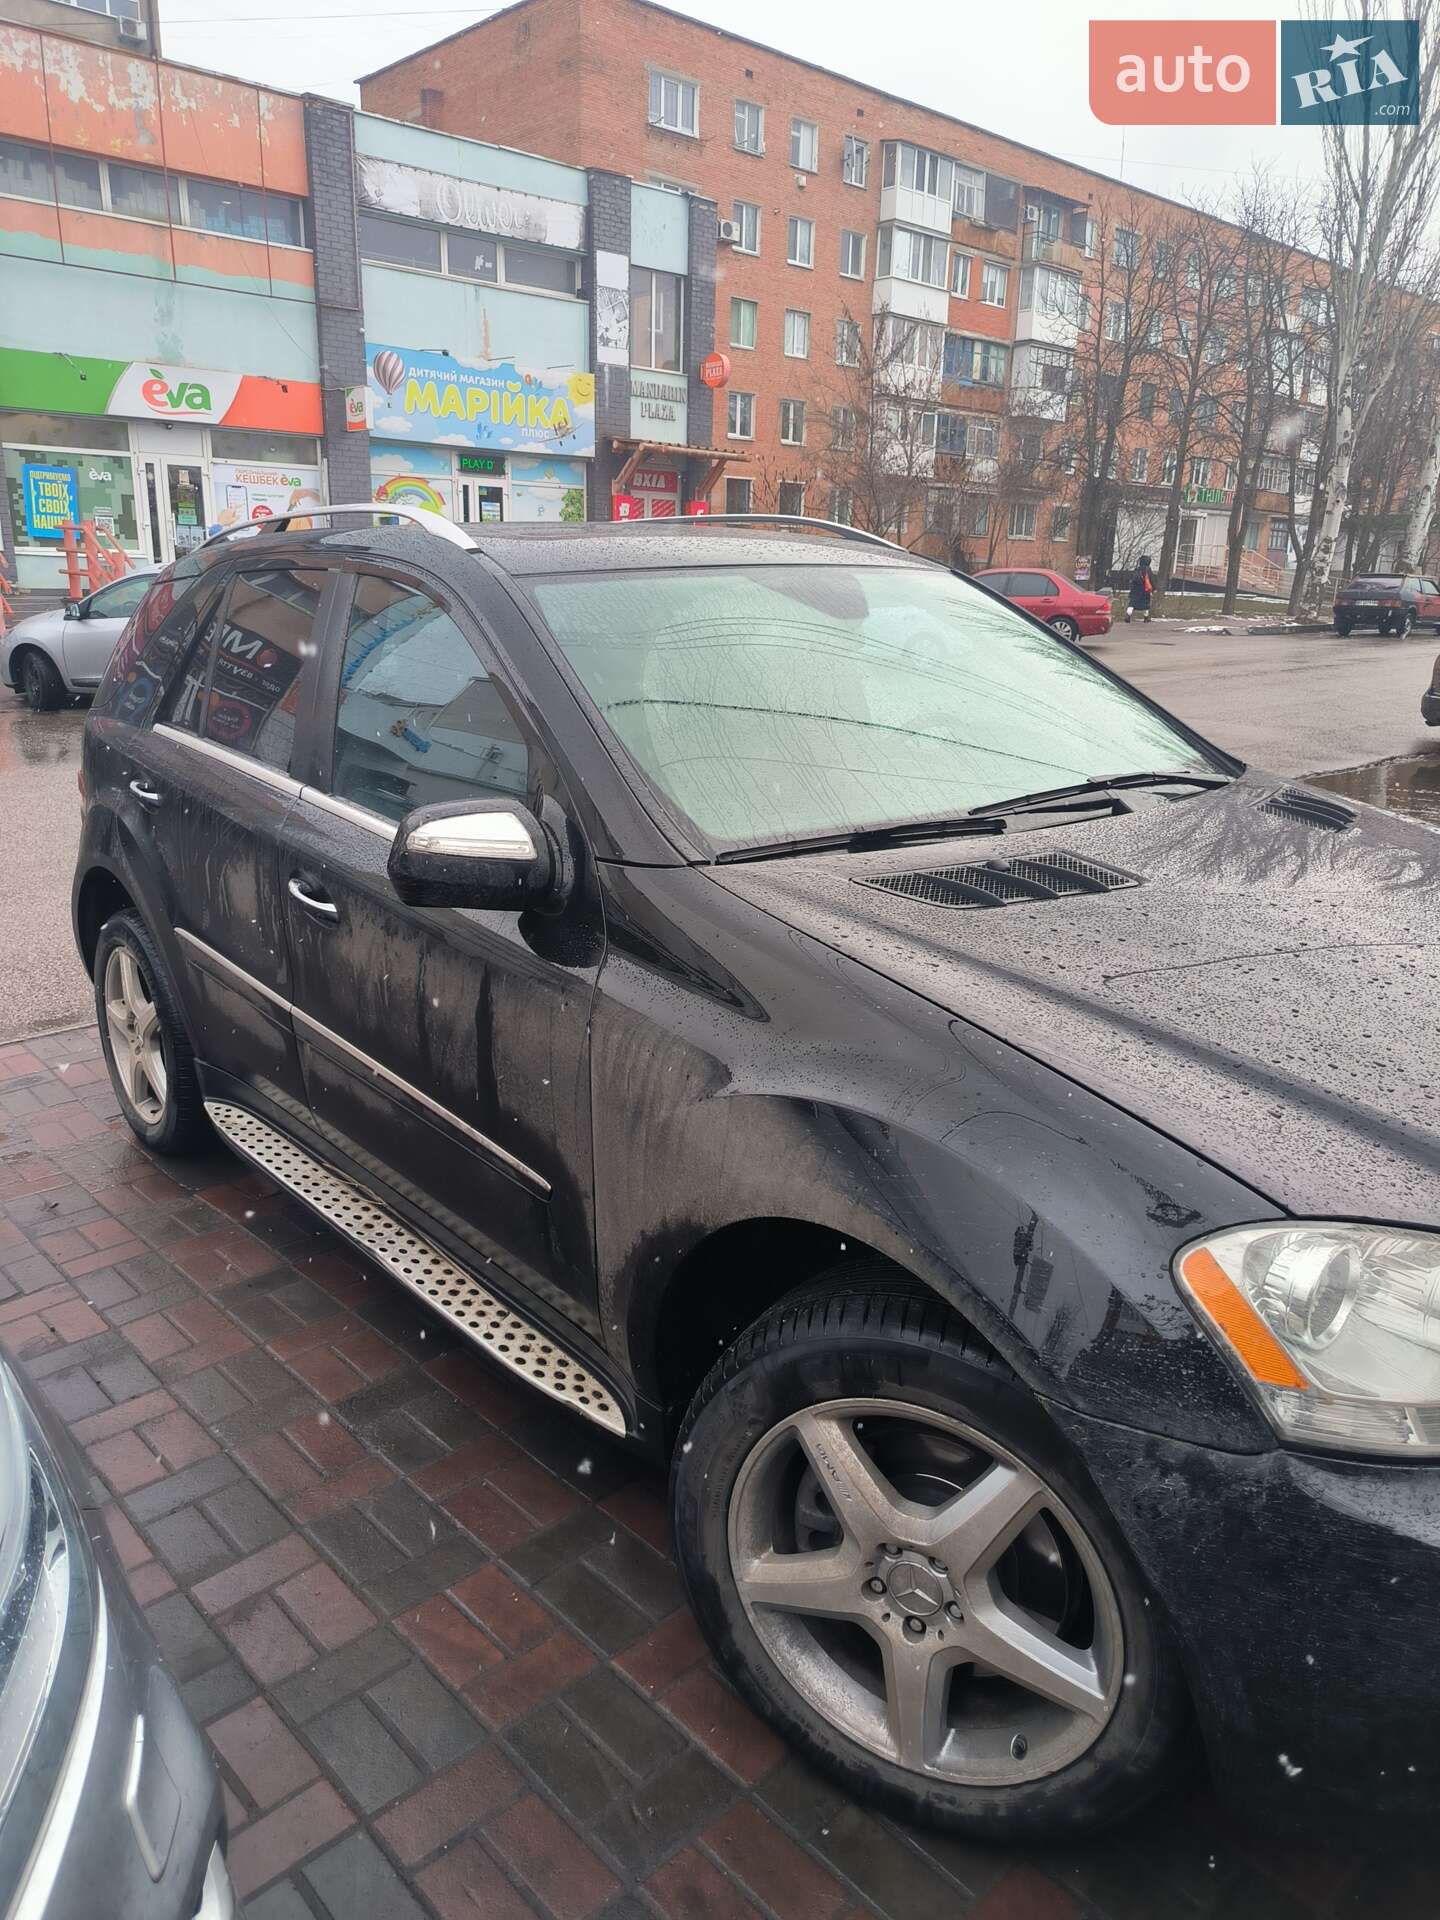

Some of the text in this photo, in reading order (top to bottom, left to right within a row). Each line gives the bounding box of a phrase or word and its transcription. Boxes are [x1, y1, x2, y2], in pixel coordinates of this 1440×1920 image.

[408, 367, 505, 388] ДИТЯЧИЙ МАГАЗИН
[404, 379, 572, 429] МАРІЙКА
[640, 401, 676, 421] PLAZA
[462, 457, 485, 470] PLAY
[235, 473, 279, 486] КЕШБЕК
